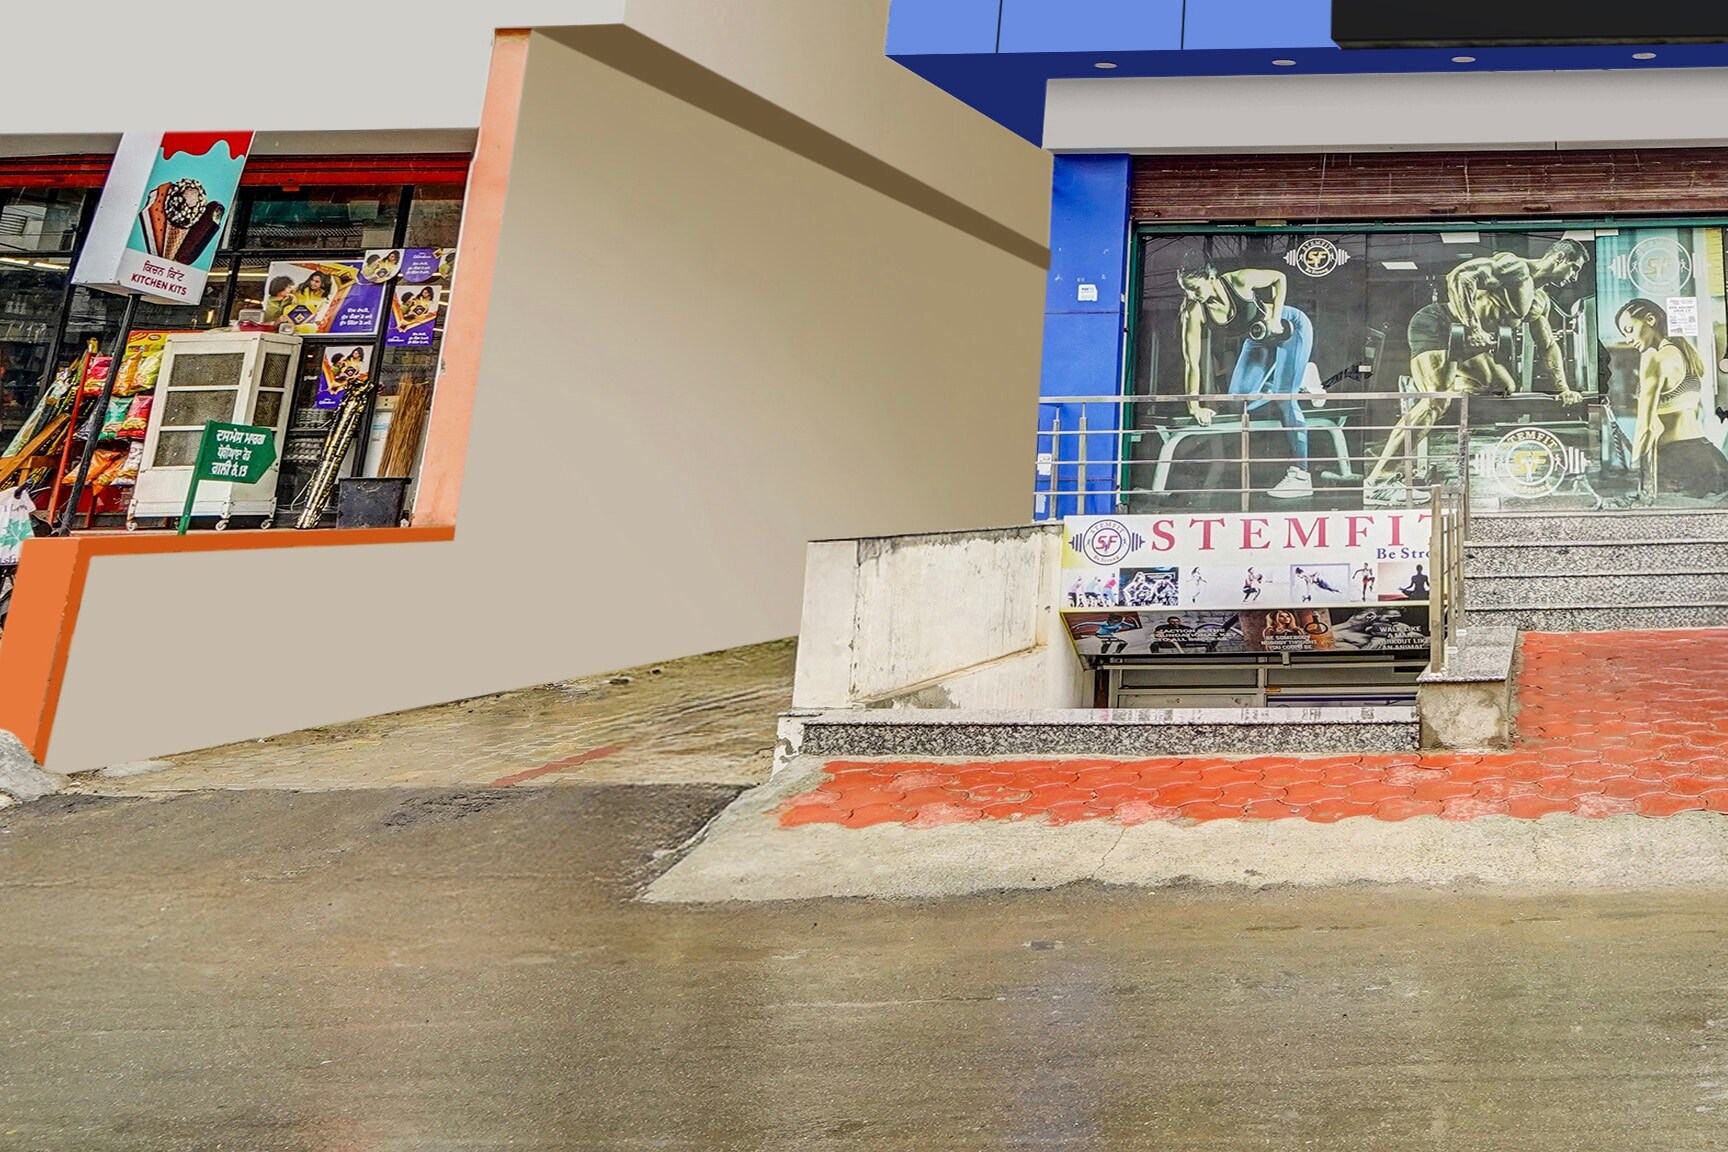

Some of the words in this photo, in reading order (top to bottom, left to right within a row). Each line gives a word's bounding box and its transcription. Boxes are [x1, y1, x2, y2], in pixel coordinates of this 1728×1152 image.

[131, 273, 168, 291] KITCHEN
[168, 284, 187, 296] KITS
[1377, 548, 1396, 559] Be
